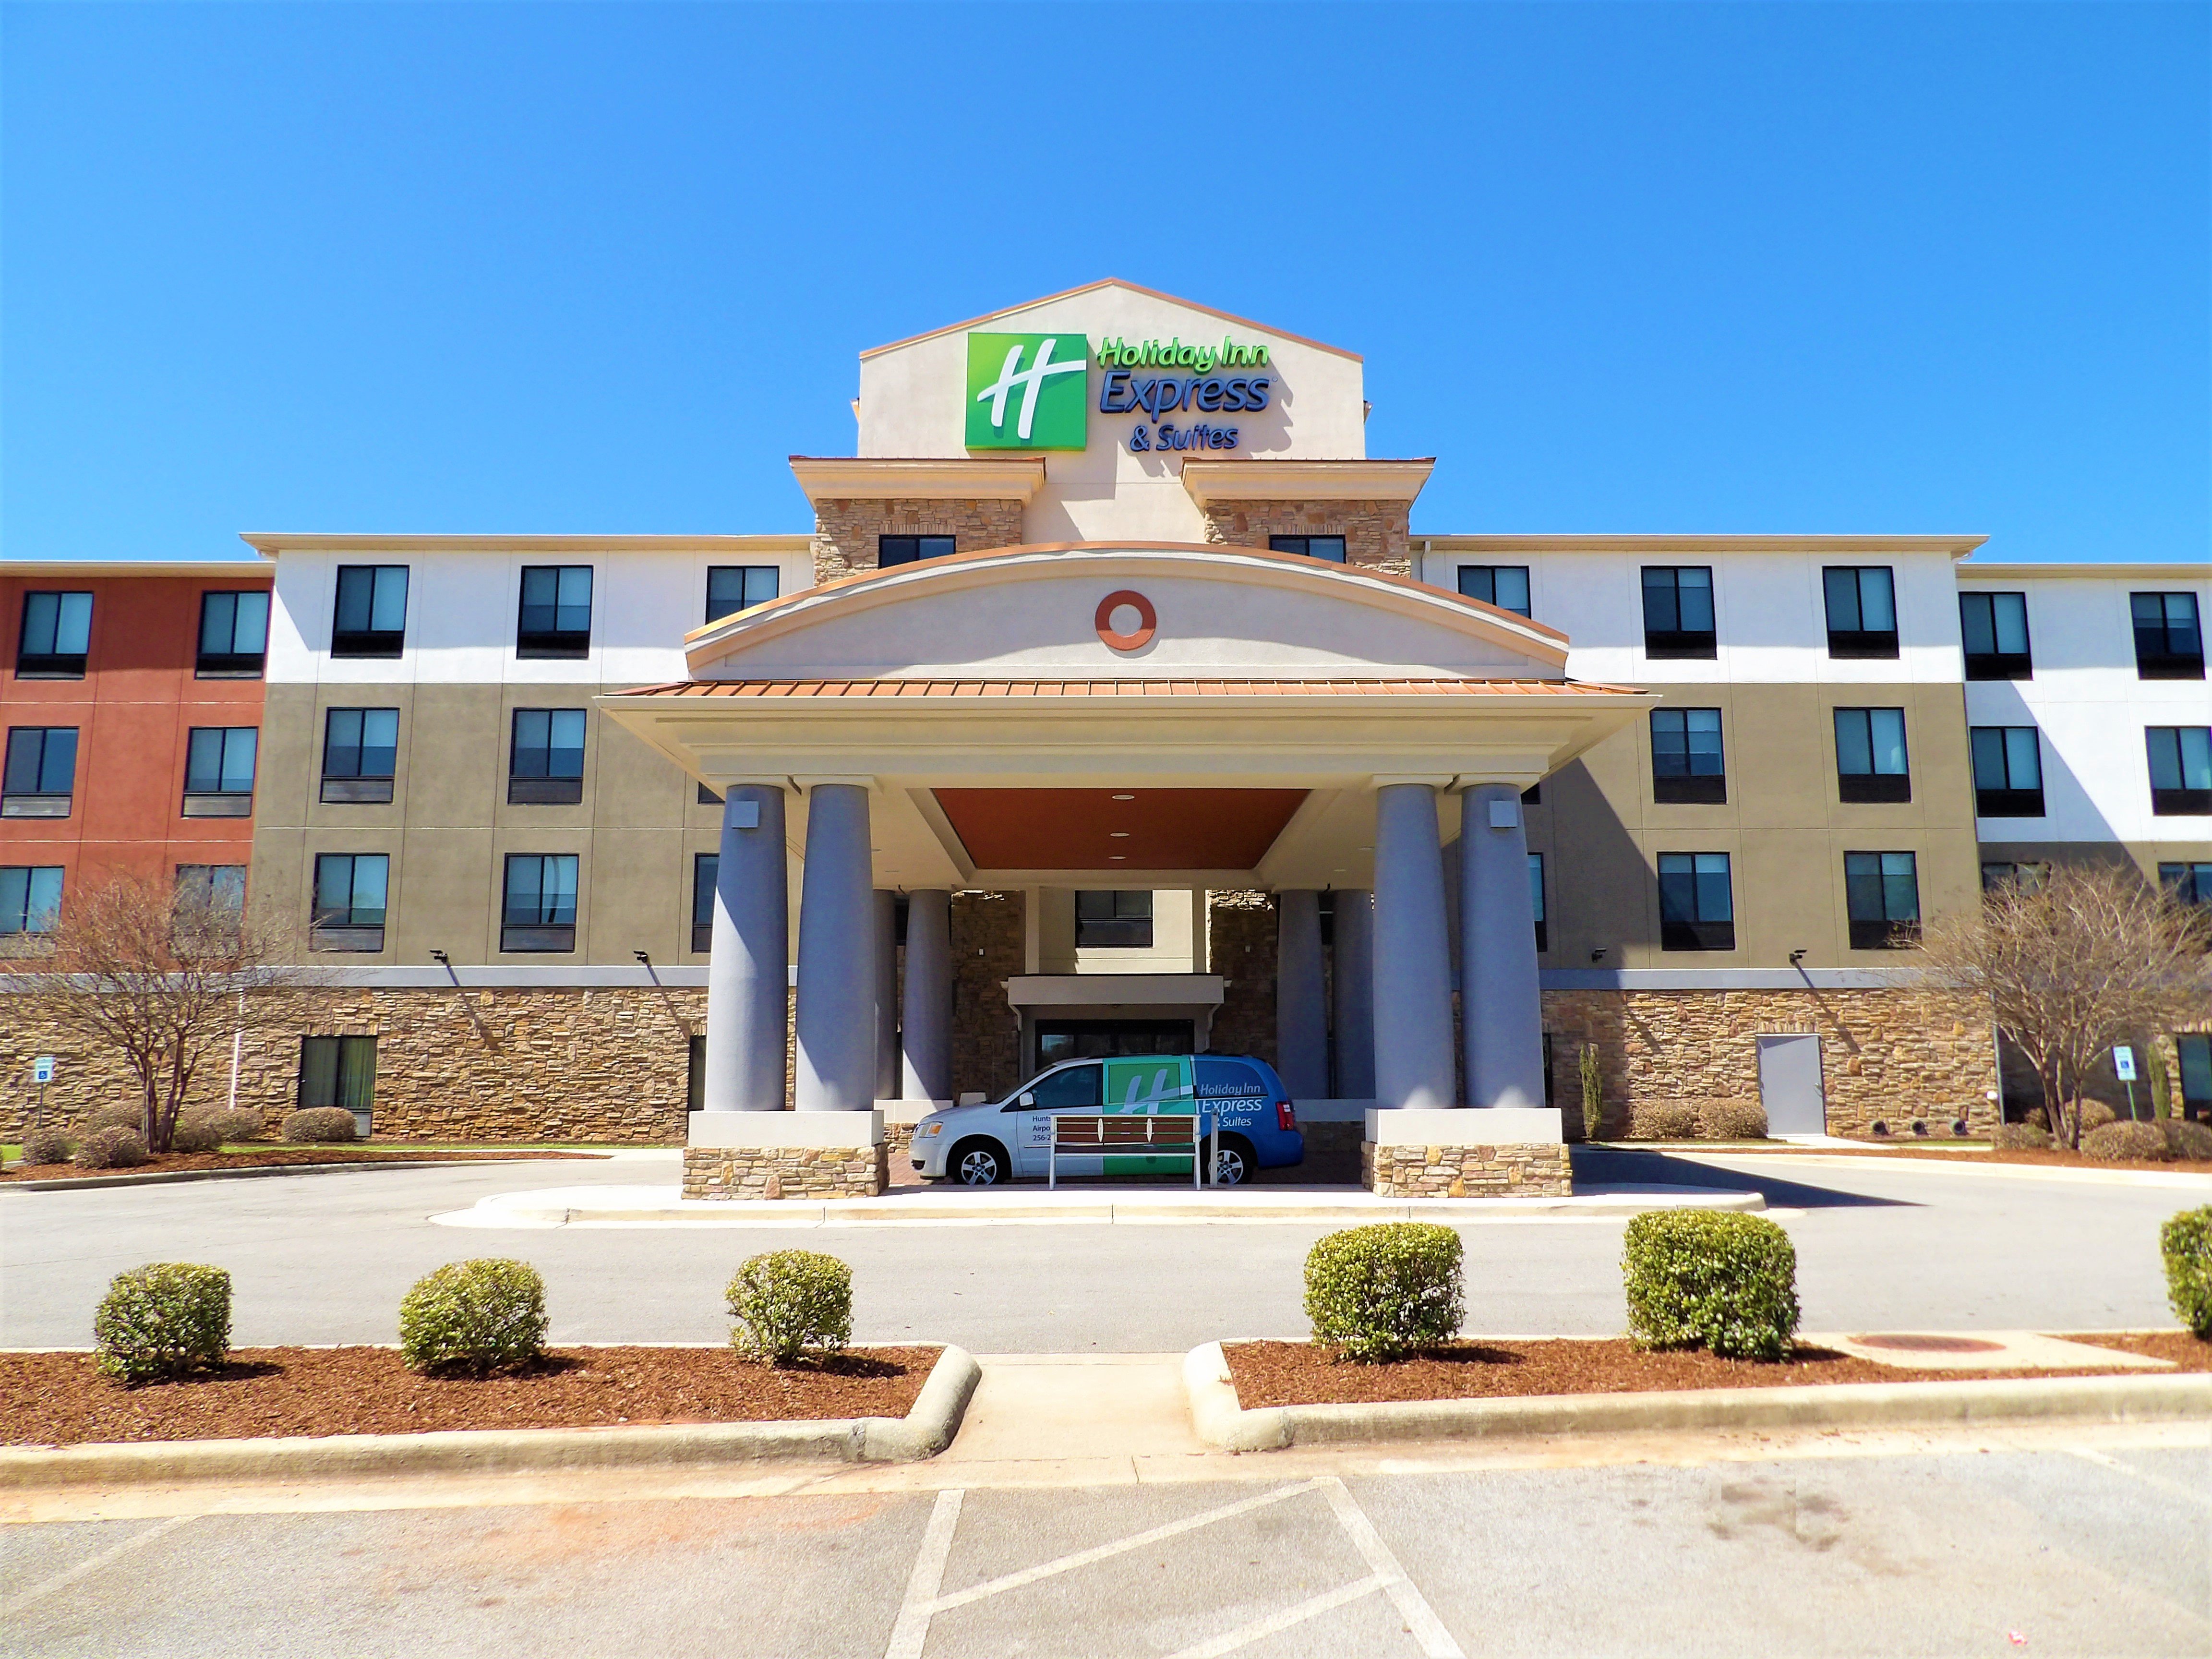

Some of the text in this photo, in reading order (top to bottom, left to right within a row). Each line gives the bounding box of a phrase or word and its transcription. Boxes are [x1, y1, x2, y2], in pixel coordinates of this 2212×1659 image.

[1097, 336, 1269, 374] Holiday Inn
[977, 338, 1086, 439] H
[1100, 371, 1270, 423] Express
[1130, 424, 1238, 452] & Suites
[1201, 1082, 1261, 1095] Holiday Inn
[1202, 1099, 1262, 1116] Express
[1223, 1117, 1252, 1127] Suites
